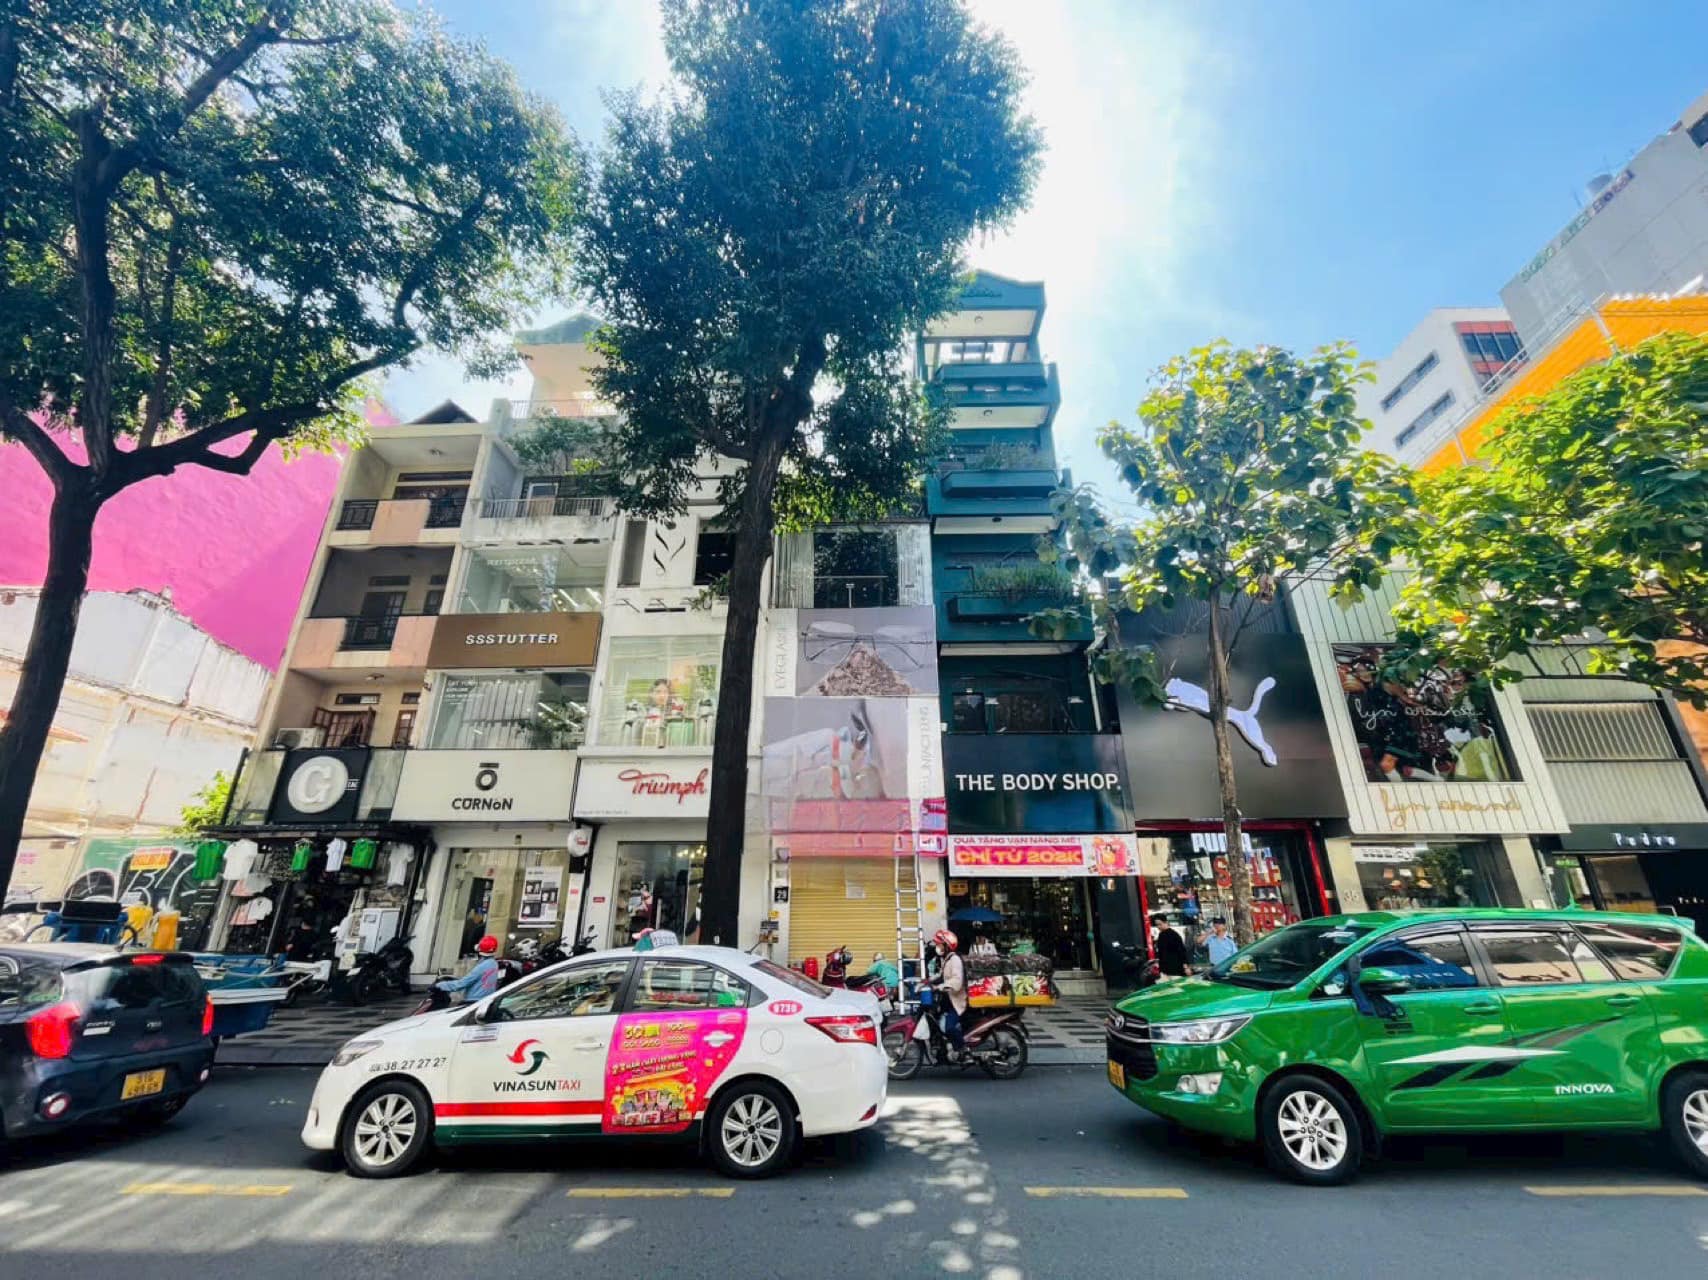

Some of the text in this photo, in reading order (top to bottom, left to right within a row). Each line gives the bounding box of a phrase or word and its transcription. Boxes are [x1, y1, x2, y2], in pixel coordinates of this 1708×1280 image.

[465, 634, 558, 645] SSSTUTTER
[618, 768, 709, 804] Triumph
[955, 774, 995, 791] THE
[1002, 774, 1057, 791] BODY
[1379, 787, 1430, 827] lyn
[1213, 855, 1283, 888] SLE
[401, 1060, 415, 1070] 27
[417, 1058, 431, 1069] 27
[1555, 1083, 1615, 1095] INNOVA
